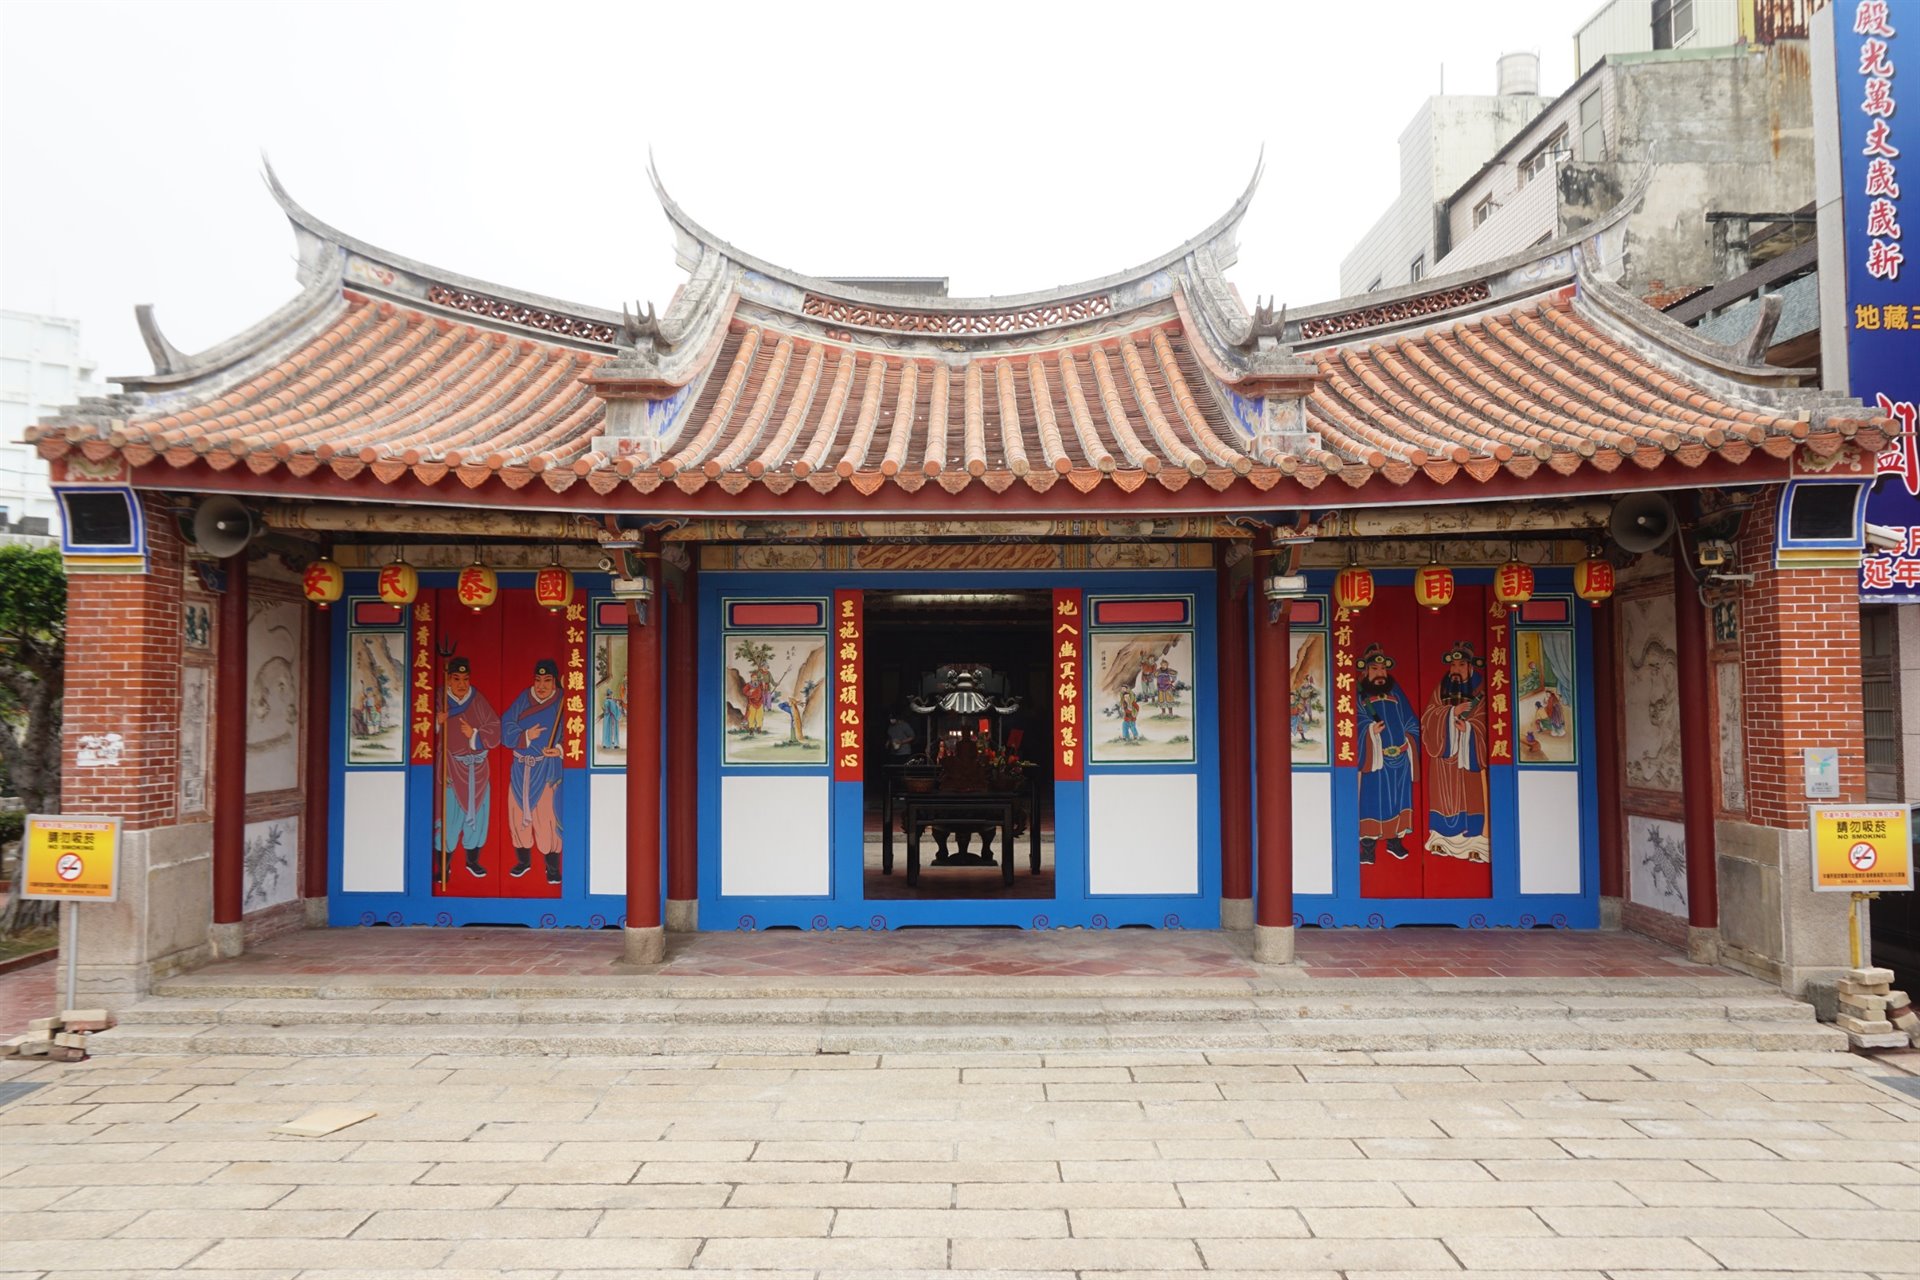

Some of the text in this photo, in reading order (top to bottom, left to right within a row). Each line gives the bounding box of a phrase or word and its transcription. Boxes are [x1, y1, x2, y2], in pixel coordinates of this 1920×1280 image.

[1853, 1, 1904, 279] 殿光萬丈歲歲新
[303, 563, 333, 597] 安
[380, 566, 409, 598] 民
[458, 569, 492, 601] 泰
[540, 570, 566, 601] 國
[1340, 571, 1372, 602] 順
[1424, 569, 1454, 599] 雨
[1502, 565, 1534, 596] 調
[1583, 560, 1615, 594] 風
[1837, 821, 1886, 833] 請勿吸菸
